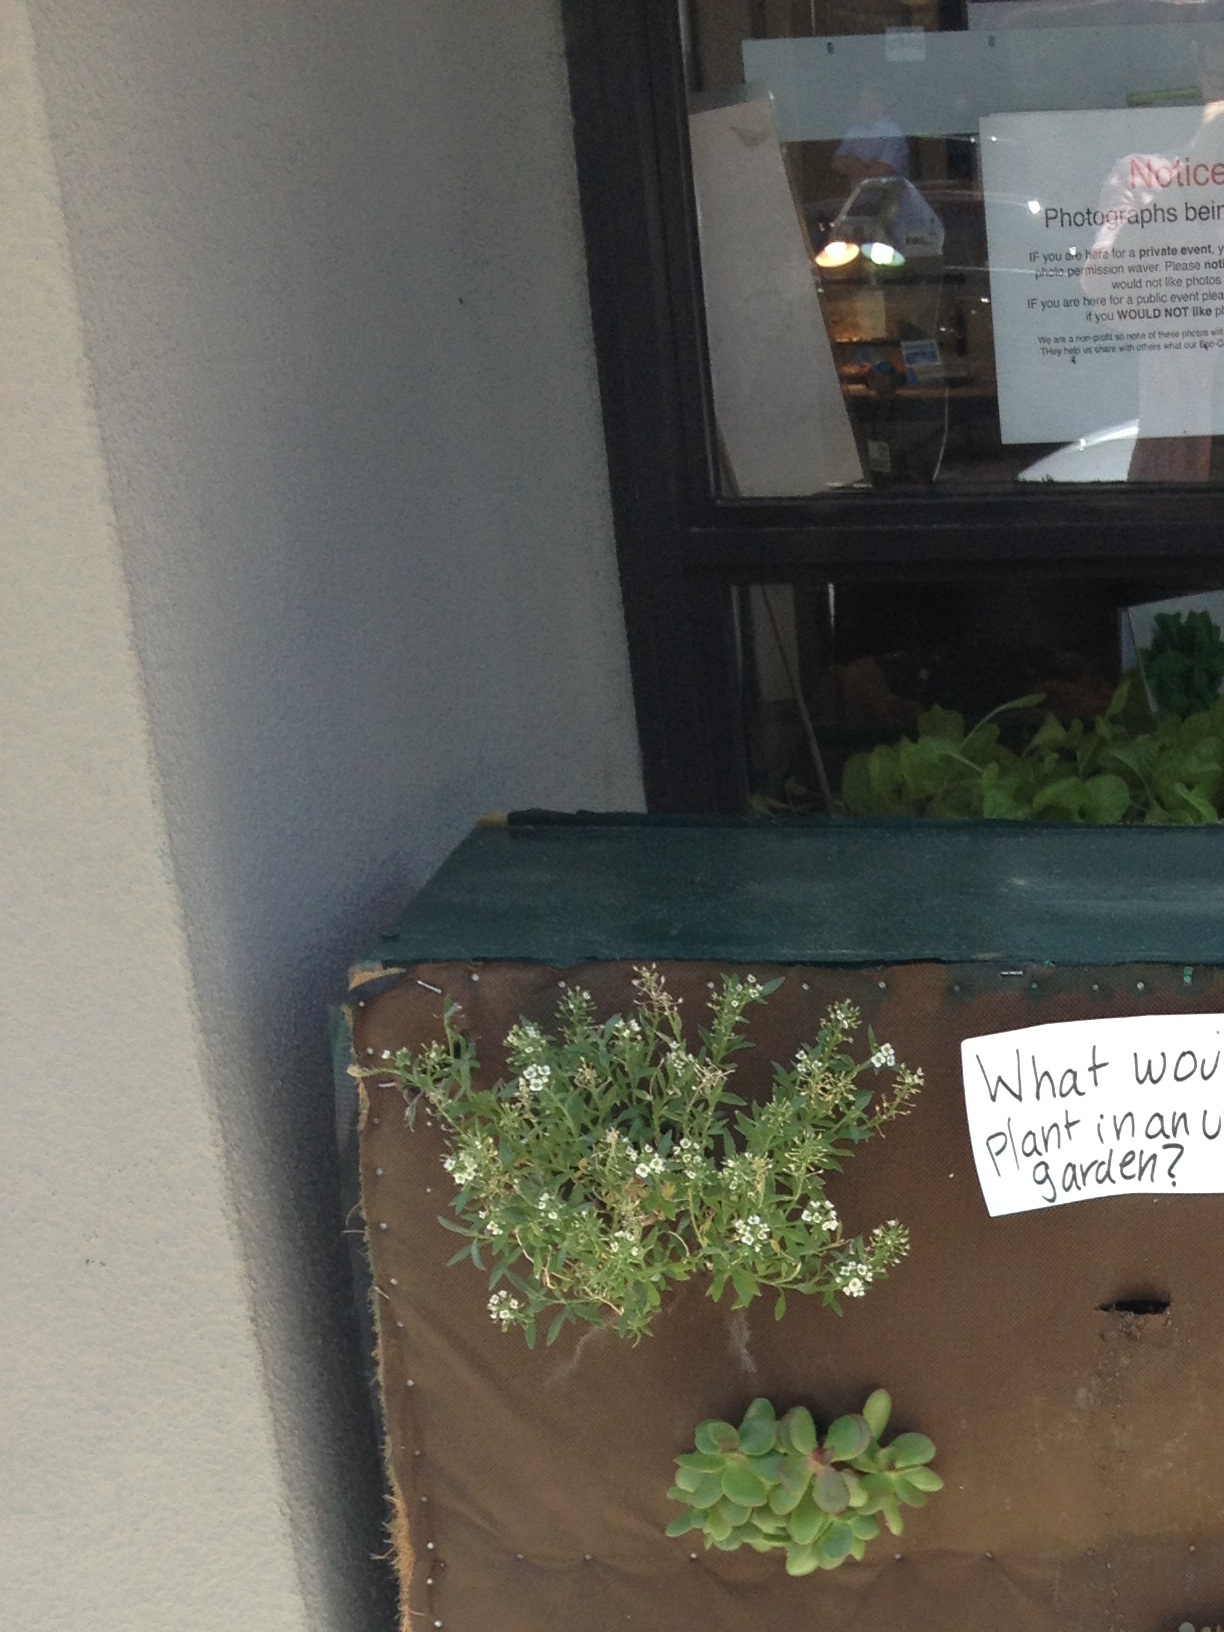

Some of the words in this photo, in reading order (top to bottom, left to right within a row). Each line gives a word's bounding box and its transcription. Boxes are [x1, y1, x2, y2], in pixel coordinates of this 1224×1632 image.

[1045, 202, 1178, 230] Photographs
[1029, 252, 1039, 263] IF
[1043, 252, 1062, 264] you
[1065, 251, 1081, 261] are
[1085, 249, 1109, 260] here
[1112, 248, 1125, 259] for
[1128, 250, 1136, 258] a
[1139, 246, 1178, 260] private
[1180, 245, 1215, 256] event,
[1035, 266, 1064, 280] photo
[1067, 262, 1124, 278] permission
[1165, 259, 1201, 272] Please
[1112, 278, 1142, 290] would
[1145, 277, 1162, 288] not
[1165, 275, 1183, 287] like
[1186, 274, 1222, 287] photos
[1027, 298, 1037, 309] IF
[1040, 299, 1060, 311] you
[1063, 298, 1080, 308] are
[1083, 296, 1107, 307] here
[1109, 294, 1123, 305] for
[1136, 292, 1168, 307] public
[1170, 291, 1199, 302] event
[1085, 311, 1093, 322] if
[1094, 311, 1114, 324] you
[1116, 306, 1161, 320] WOULD
[1164, 305, 1189, 318] NOT
[1192, 304, 1213, 317] like
[976, 1045, 1109, 1102] What
[986, 1109, 1081, 1177] plant
[1033, 1143, 1184, 1203] garden?
